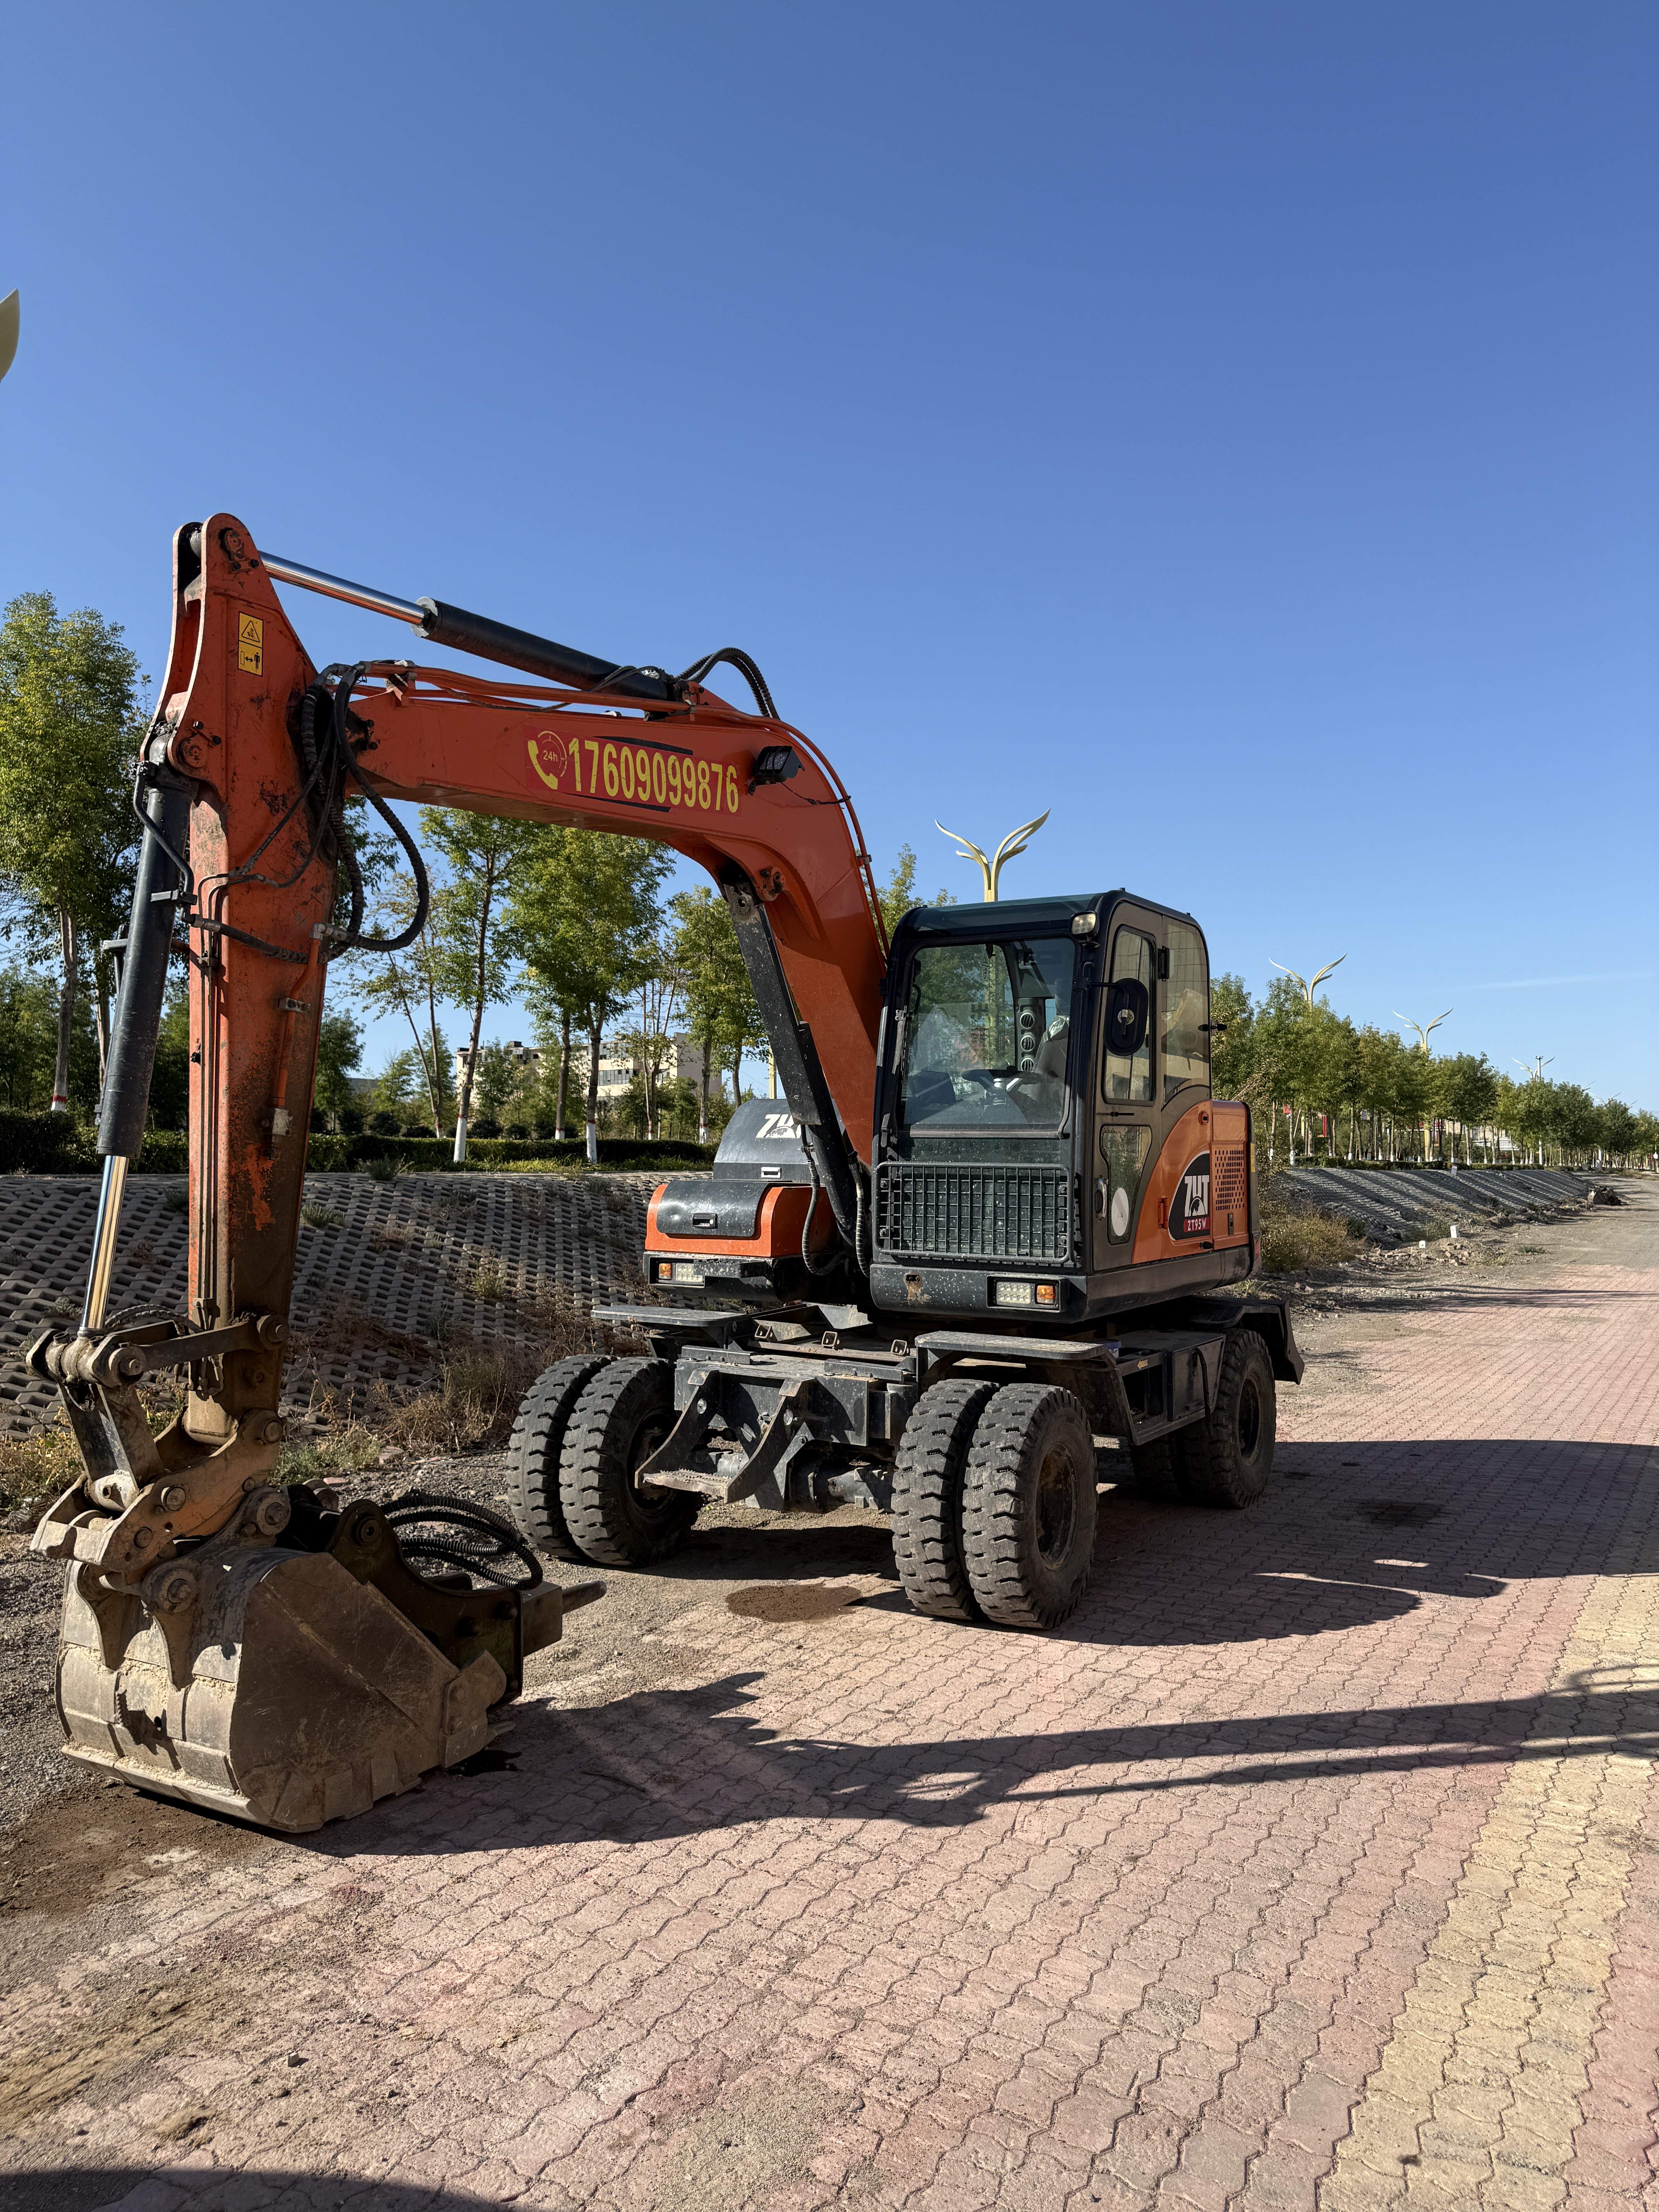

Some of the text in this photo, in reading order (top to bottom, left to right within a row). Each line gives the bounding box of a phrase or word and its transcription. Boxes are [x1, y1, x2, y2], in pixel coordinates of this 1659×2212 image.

[543, 750, 558, 762] 24h
[568, 738, 739, 813] 17609099876
[756, 1114, 802, 1139] ZU
[1187, 1218, 1207, 1231] ZT95W
